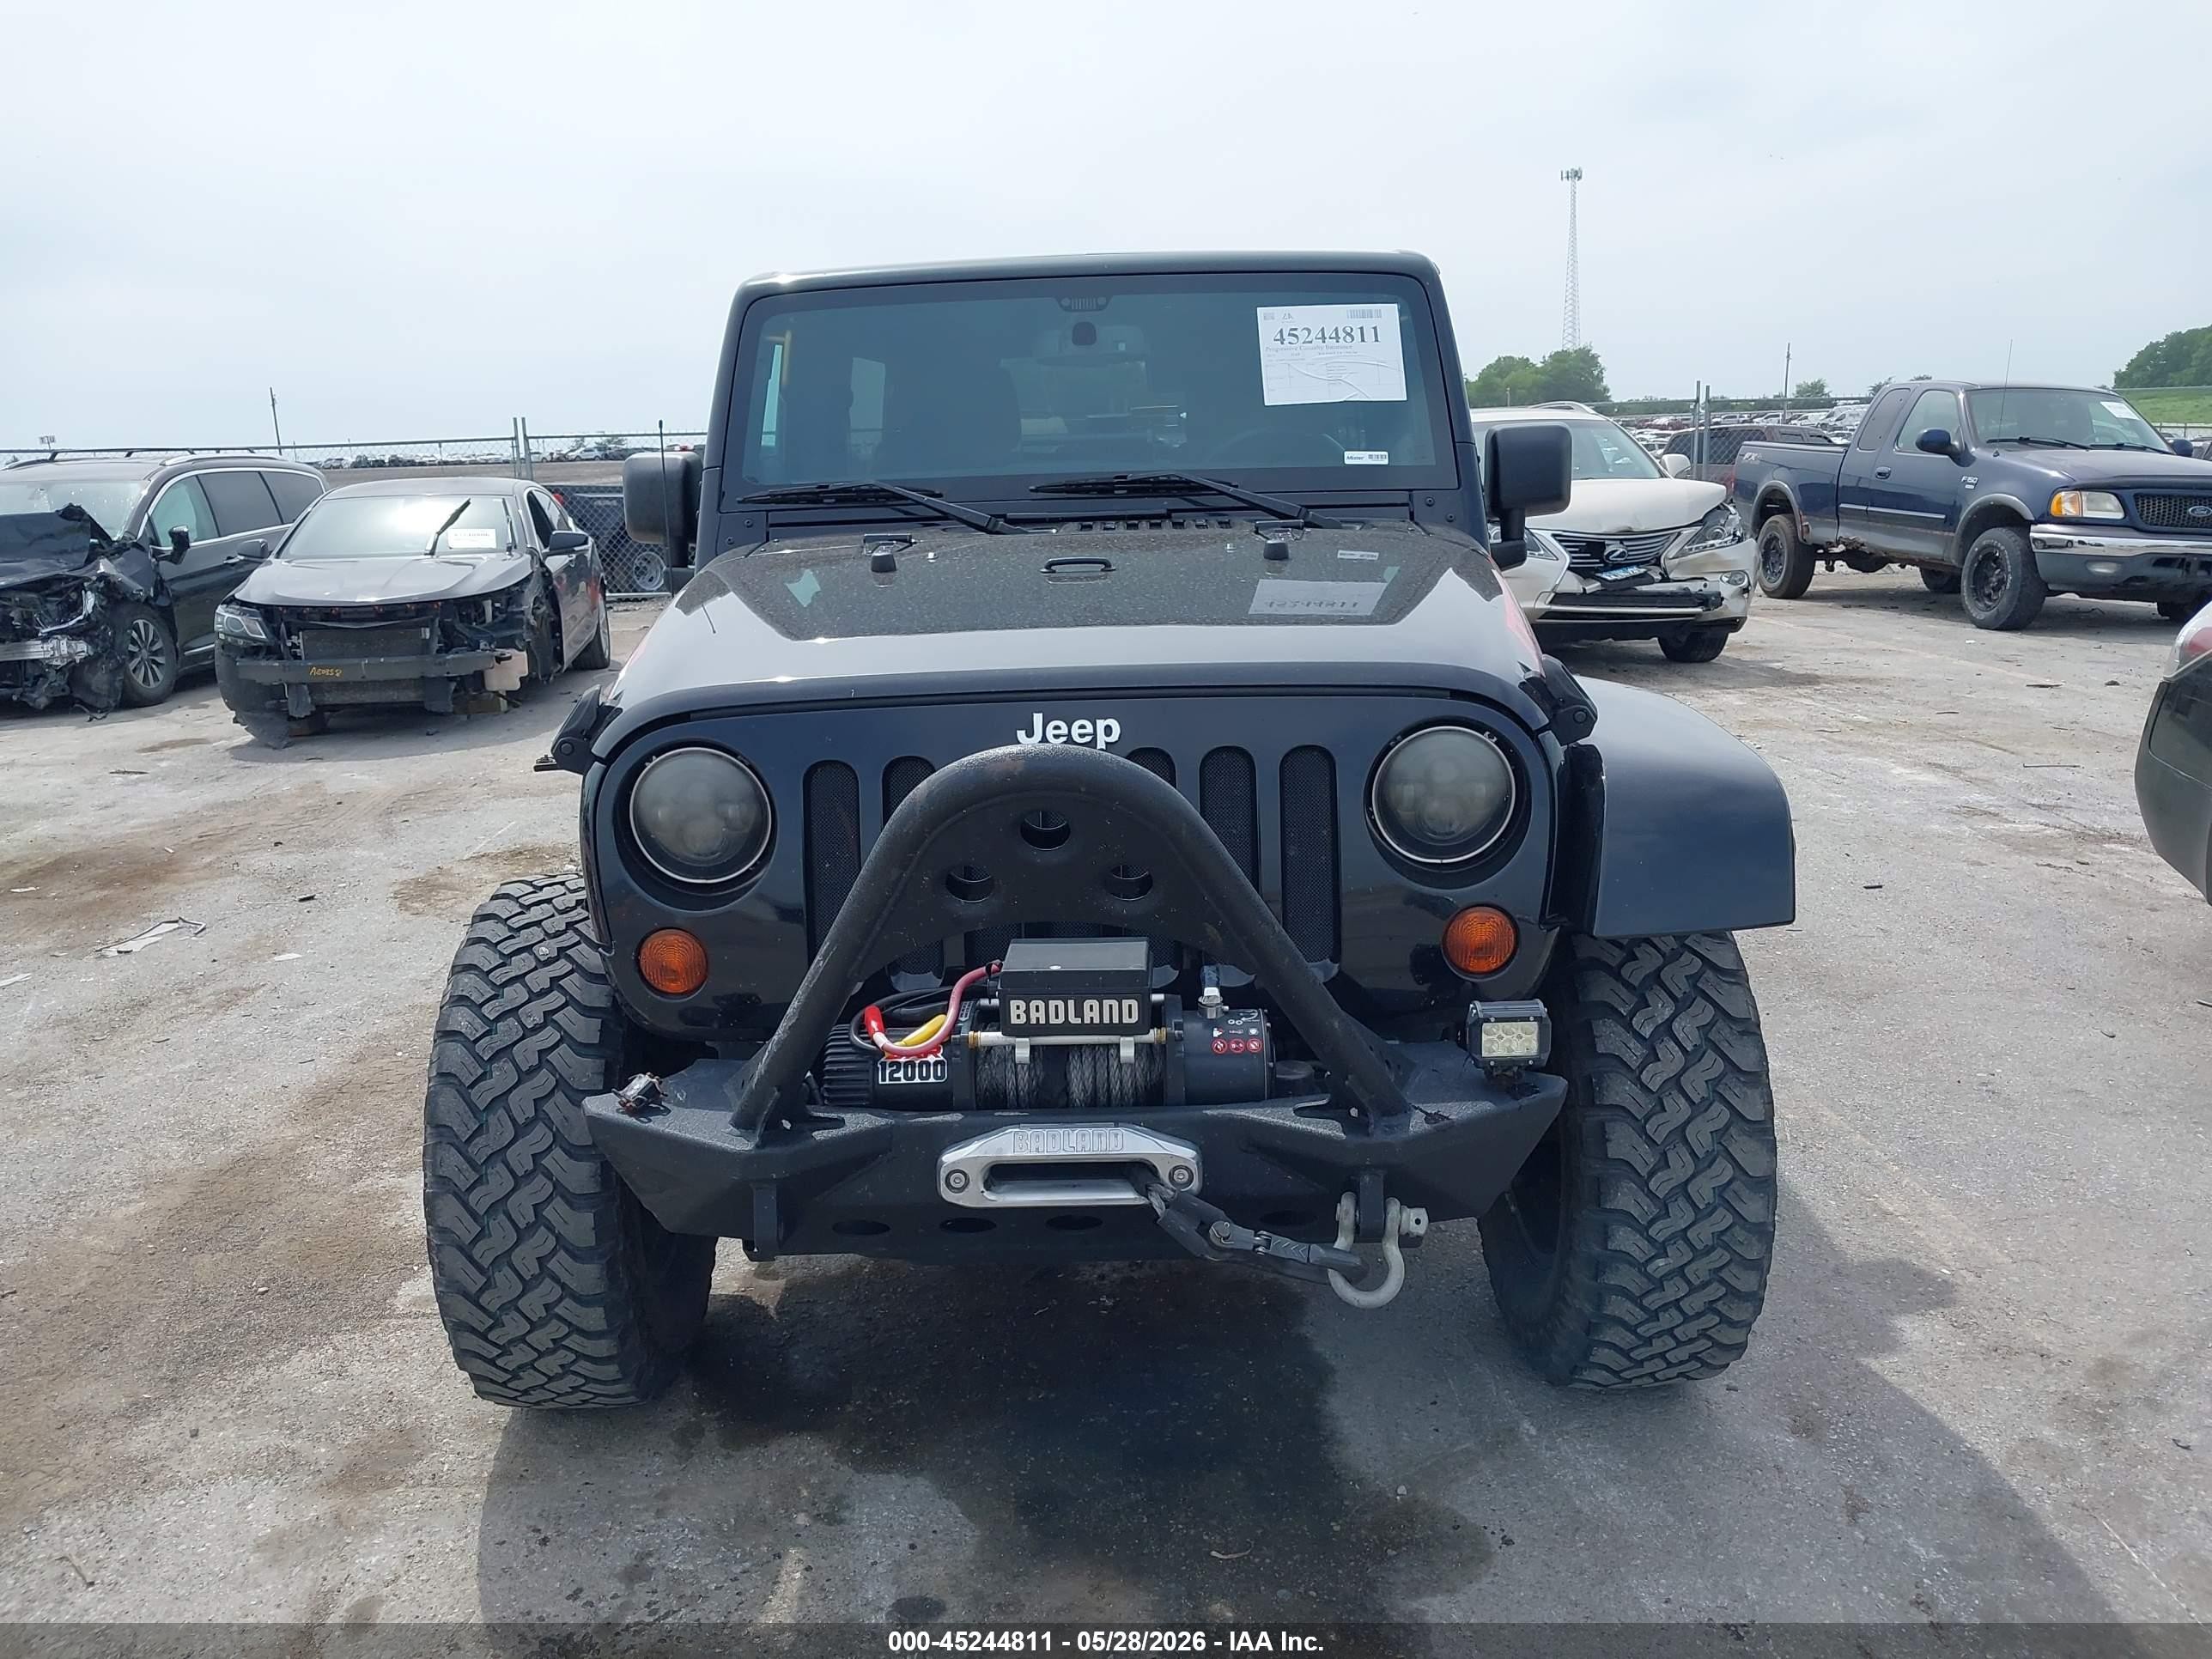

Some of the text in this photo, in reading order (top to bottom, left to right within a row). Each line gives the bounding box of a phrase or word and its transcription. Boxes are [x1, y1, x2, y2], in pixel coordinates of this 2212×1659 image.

[1273, 325, 1381, 344] 45244811
[1017, 712, 1121, 750] Jeep
[1009, 999, 1139, 1024] BADLAND
[878, 1059, 946, 1083] 12000
[1013, 1128, 1124, 1153] BADLAND
